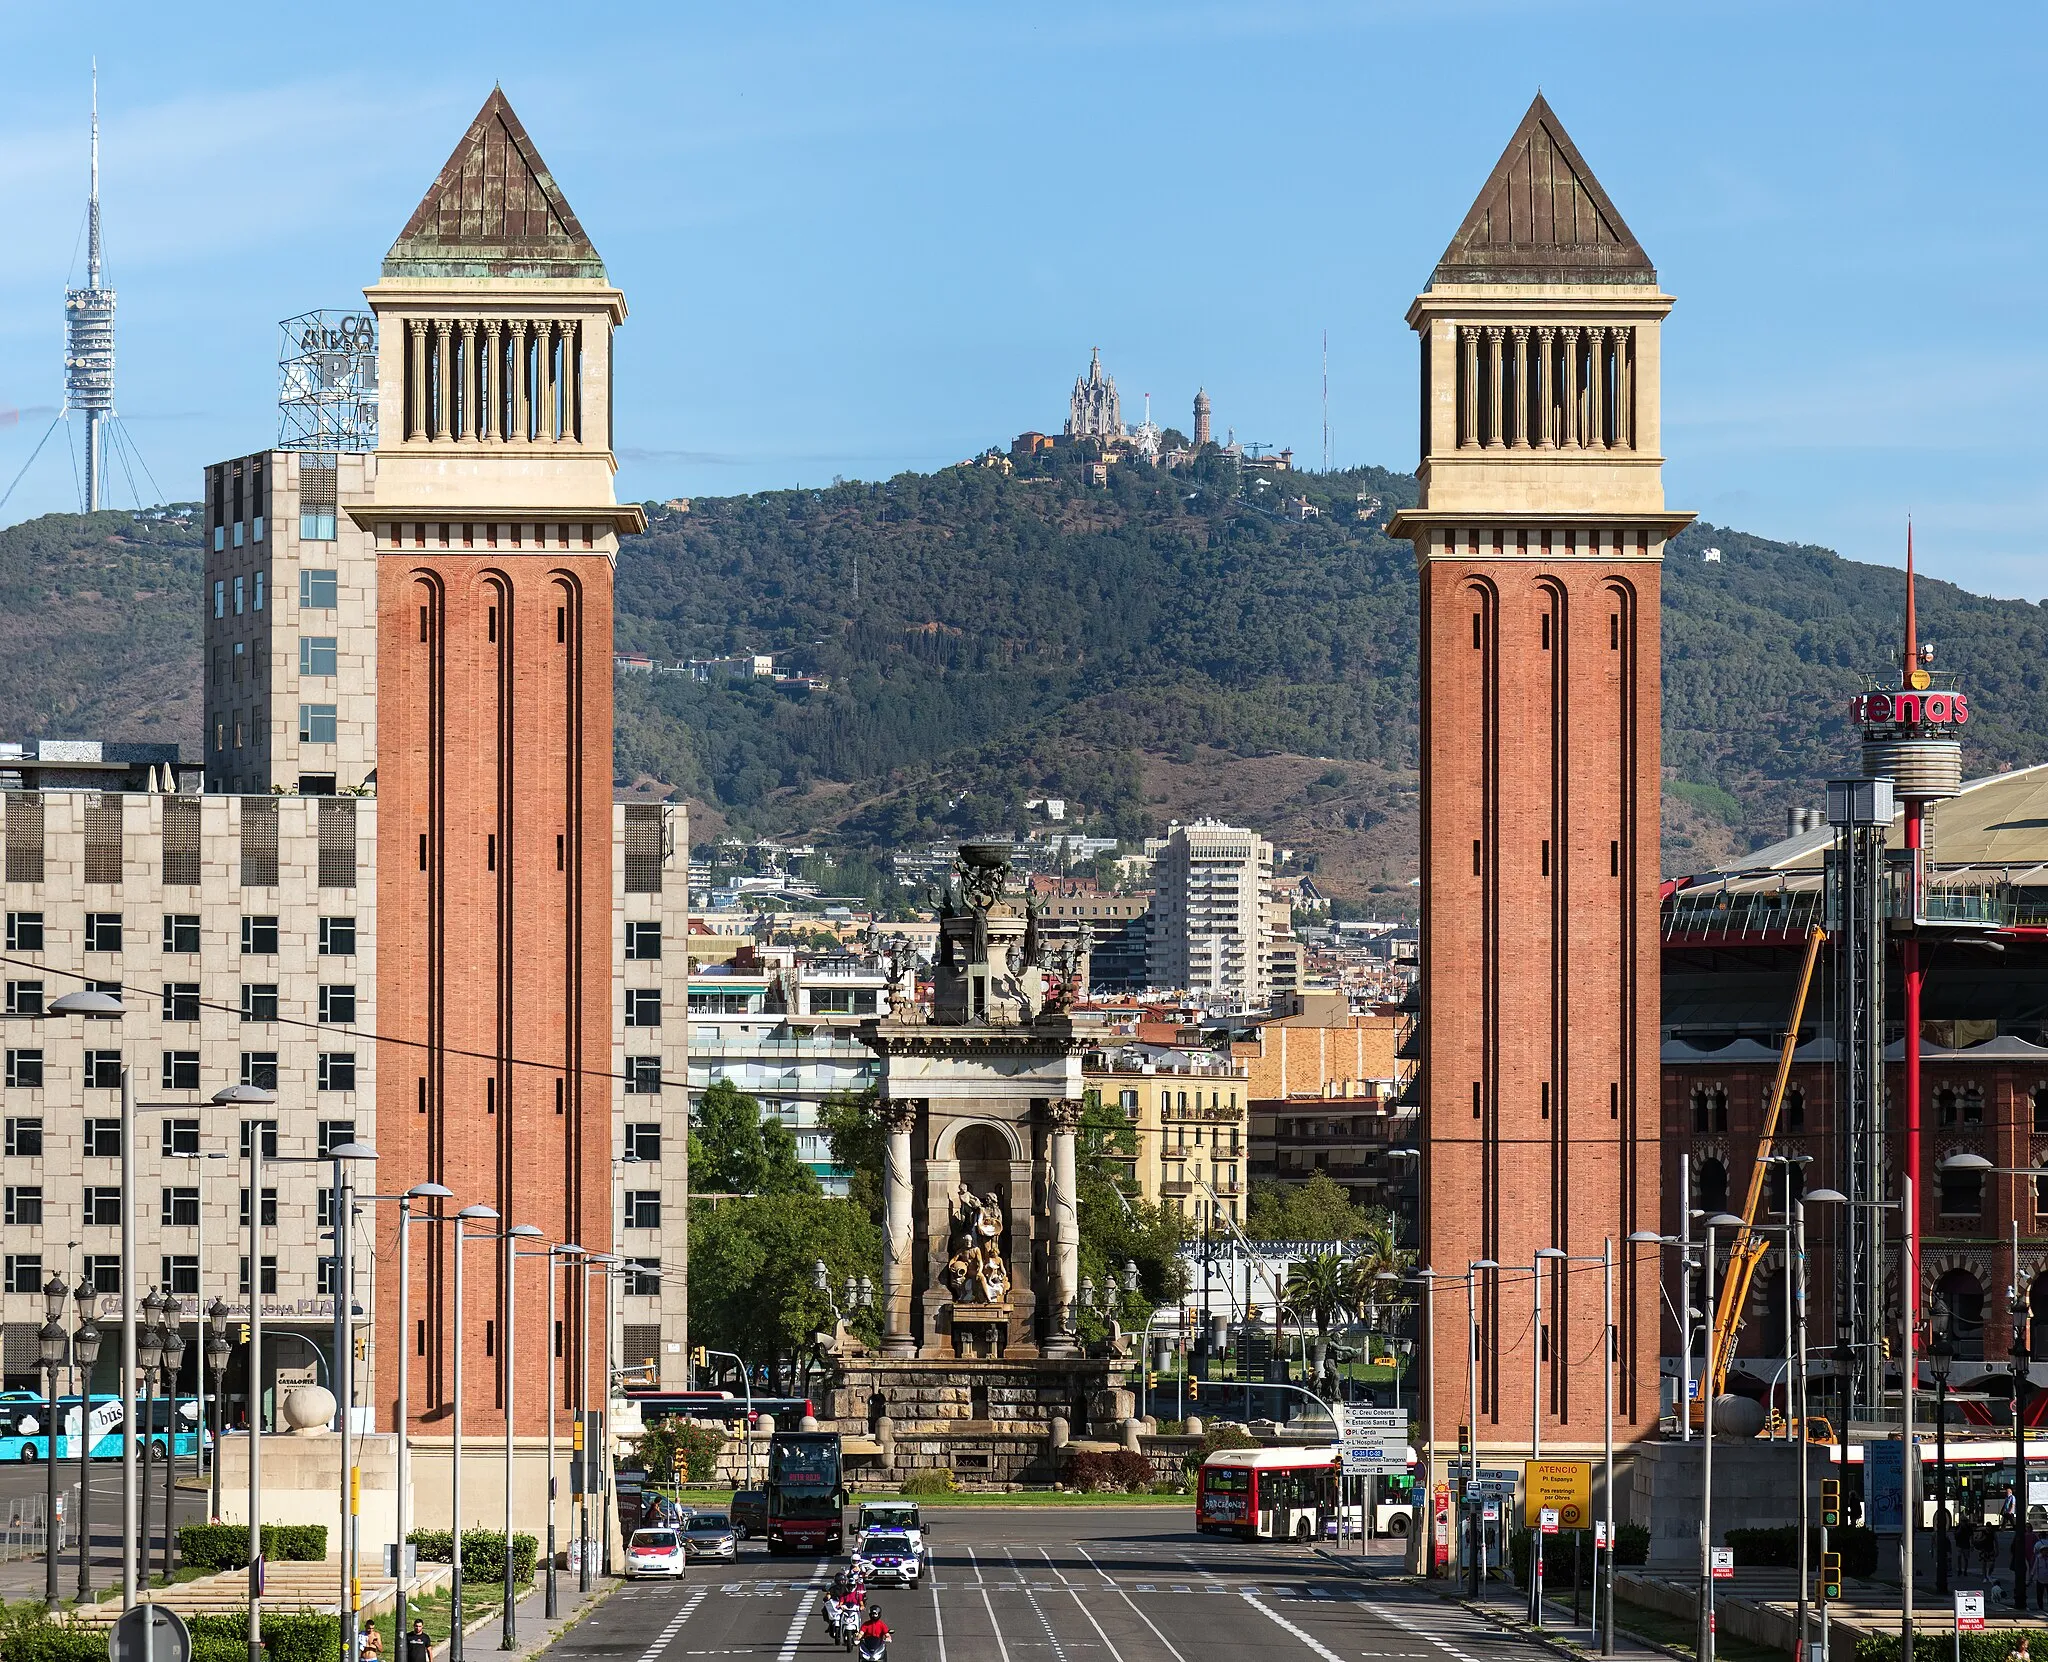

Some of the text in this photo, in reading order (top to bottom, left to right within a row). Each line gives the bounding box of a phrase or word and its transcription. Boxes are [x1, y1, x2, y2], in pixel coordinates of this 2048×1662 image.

[1352, 1439, 1384, 1447] L'Hospitalet
[1539, 1465, 1578, 1474] ATENCIÓ
[1565, 1510, 1577, 1518] 30
